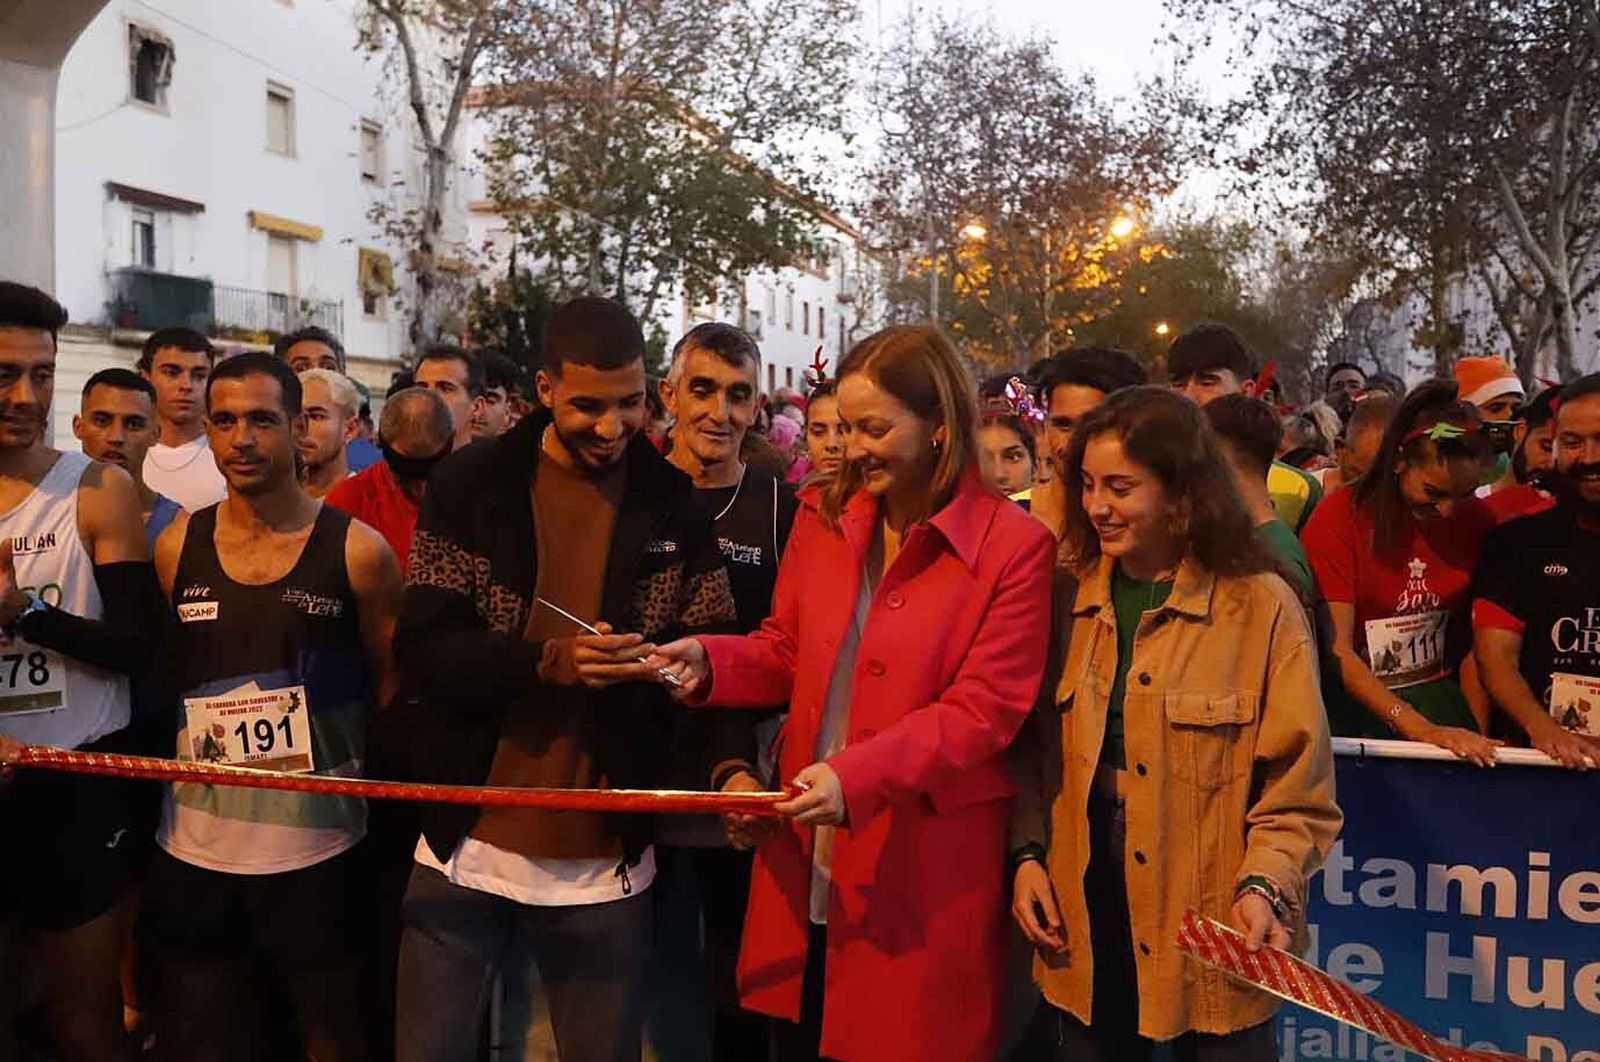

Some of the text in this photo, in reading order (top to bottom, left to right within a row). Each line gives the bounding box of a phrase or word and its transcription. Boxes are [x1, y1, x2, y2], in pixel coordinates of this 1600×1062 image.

[1408, 631, 1438, 663] 111
[0, 652, 49, 688] 78
[234, 715, 294, 754] 191
[1307, 838, 1600, 924] tamie
